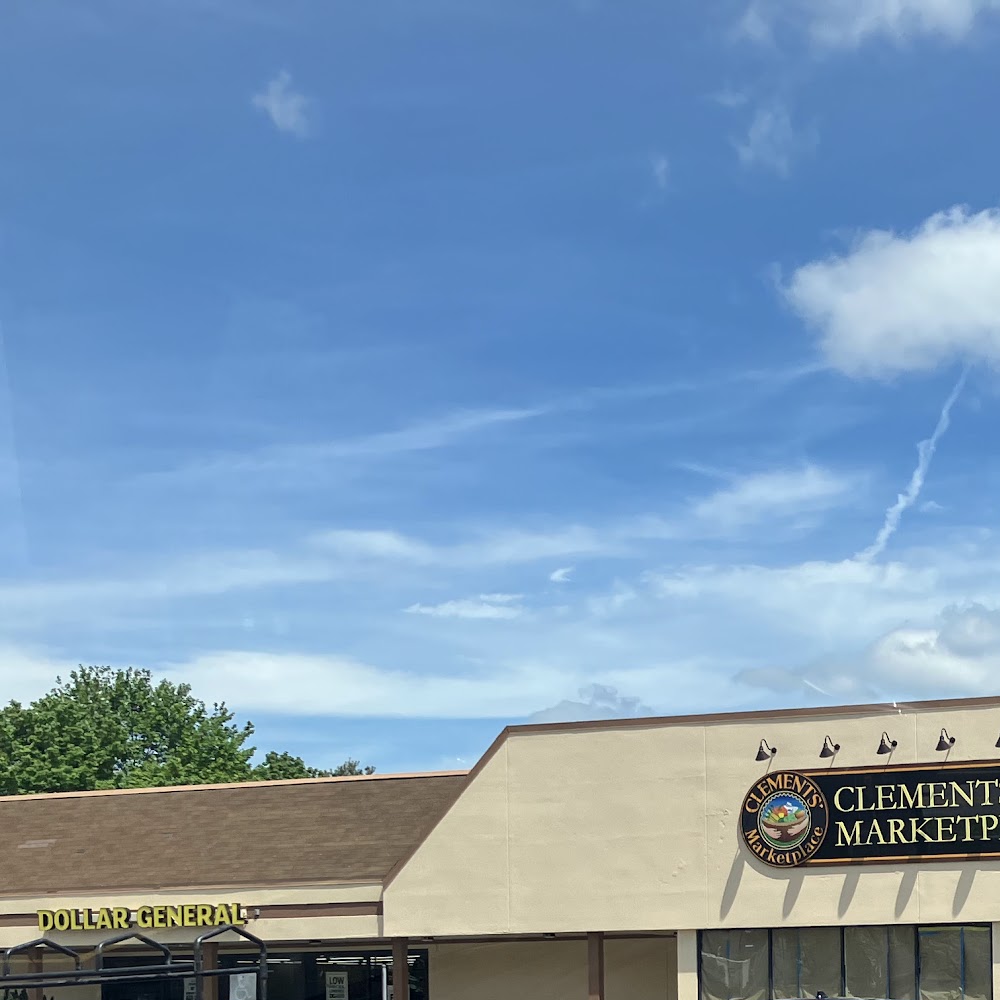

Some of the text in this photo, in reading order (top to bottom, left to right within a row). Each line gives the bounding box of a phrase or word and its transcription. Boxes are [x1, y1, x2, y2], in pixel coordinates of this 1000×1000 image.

[745, 774, 824, 813] CLEMENTS'
[745, 826, 824, 865] Marketplace
[37, 903, 246, 931] DOLLAR GENERAL
